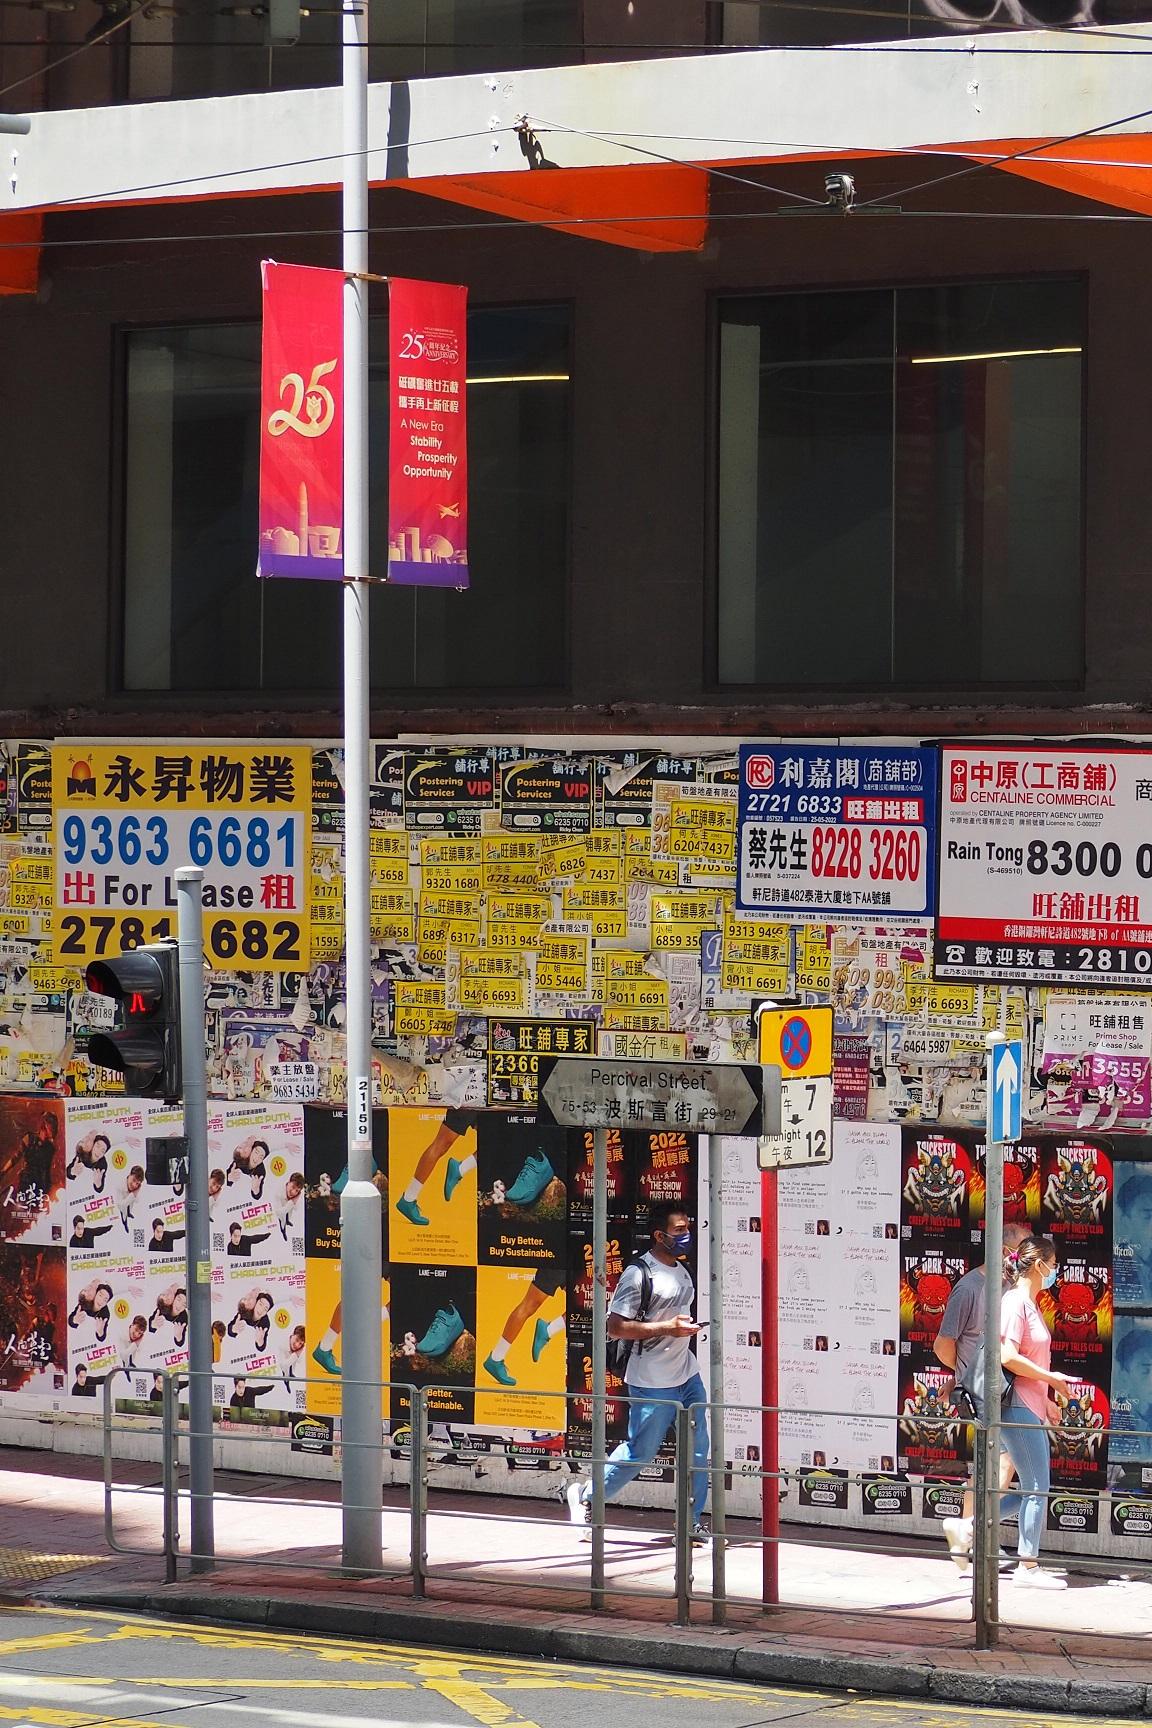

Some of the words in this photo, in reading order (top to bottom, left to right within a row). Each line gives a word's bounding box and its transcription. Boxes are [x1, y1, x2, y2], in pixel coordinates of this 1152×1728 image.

[399, 334, 424, 359] 25
[267, 358, 338, 437] 25
[401, 420, 407, 429] A
[409, 420, 428, 430] New
[430, 421, 444, 431] Era
[410, 435, 442, 449] Stability
[417, 451, 457, 466] Prosperity
[403, 466, 452, 480] Opportunity
[103, 755, 296, 803] 永昇物業
[779, 757, 859, 789] 利嘉閣
[419, 776, 463, 787] Postering
[466, 781, 491, 796] VIP
[419, 788, 455, 798] Services
[517, 778, 560, 789] Postering
[565, 782, 589, 798] VIP
[517, 789, 552, 799] Services
[970, 792, 1033, 804] CENTALINE
[1037, 793, 1116, 806] COMMERCIAL
[747, 794, 791, 812] 2721
[797, 796, 842, 813] 6833
[848, 800, 920, 820] 旺舖出租
[573, 818, 588, 827] 0710
[63, 815, 169, 865] 9363
[189, 817, 295, 868] 6681
[749, 827, 808, 870] 蔡先生
[811, 826, 861, 879] 8228
[869, 828, 920, 882] 3260
[948, 841, 980, 860] Rain
[986, 842, 1023, 866] Tong
[1027, 840, 1121, 877] 8300
[560, 857, 585, 871] 6826
[987, 867, 1023, 875] (S-469510)
[380, 869, 404, 881] 5658
[590, 869, 614, 880] 7437
[63, 871, 95, 906] 出
[104, 875, 153, 906] For
[164, 876, 254, 908] Lase
[260, 874, 296, 910] 租
[426, 878, 451, 889] 9320
[455, 878, 480, 889] 1680
[1032, 892, 1140, 922] 旺舖出租
[597, 923, 622, 933] 6317
[729, 926, 754, 936] 9313
[315, 936, 339, 947] 1595
[451, 931, 475, 944] 6317
[492, 935, 516, 945] 9313
[656, 936, 681, 946] 6859
[1078, 948, 1151, 972] 2810
[556, 976, 582, 988] 5446
[757, 977, 781, 989] 6691
[492, 990, 516, 1001] 6693
[640, 993, 664, 1004] 6691
[942, 999, 968, 1010] 6693
[400, 1019, 426, 1030] 6605
[1090, 1015, 1144, 1030] 旺舖租售
[519, 1027, 588, 1051] 旺舖專家
[1119, 1033, 1137, 1041] Shop
[615, 1034, 656, 1058] 國金行
[904, 1040, 925, 1053] 6464
[929, 1040, 949, 1053] 5987
[591, 1069, 648, 1088] Percival
[658, 1072, 706, 1091] Street
[273, 1085, 294, 1098] 9683
[295, 1085, 315, 1098] 5434
[805, 1085, 817, 1111] 7
[358, 1081, 368, 1134] 21159
[604, 1099, 692, 1123] 波斯富街
[650, 1132, 686, 1150] 2022
[805, 1130, 826, 1157] 12
[652, 1150, 690, 1168] 視聽展
[771, 1146, 793, 1160] 午夜
[650, 1181, 662, 1190] THE
[664, 1181, 681, 1190] SHOW
[650, 1191, 664, 1200] MUST
[674, 1191, 681, 1200] ON
[500, 1235, 515, 1246] Buy
[517, 1236, 544, 1246] Better.
[489, 1247, 504, 1258] Buy
[505, 1248, 555, 1259] Sustainable.
